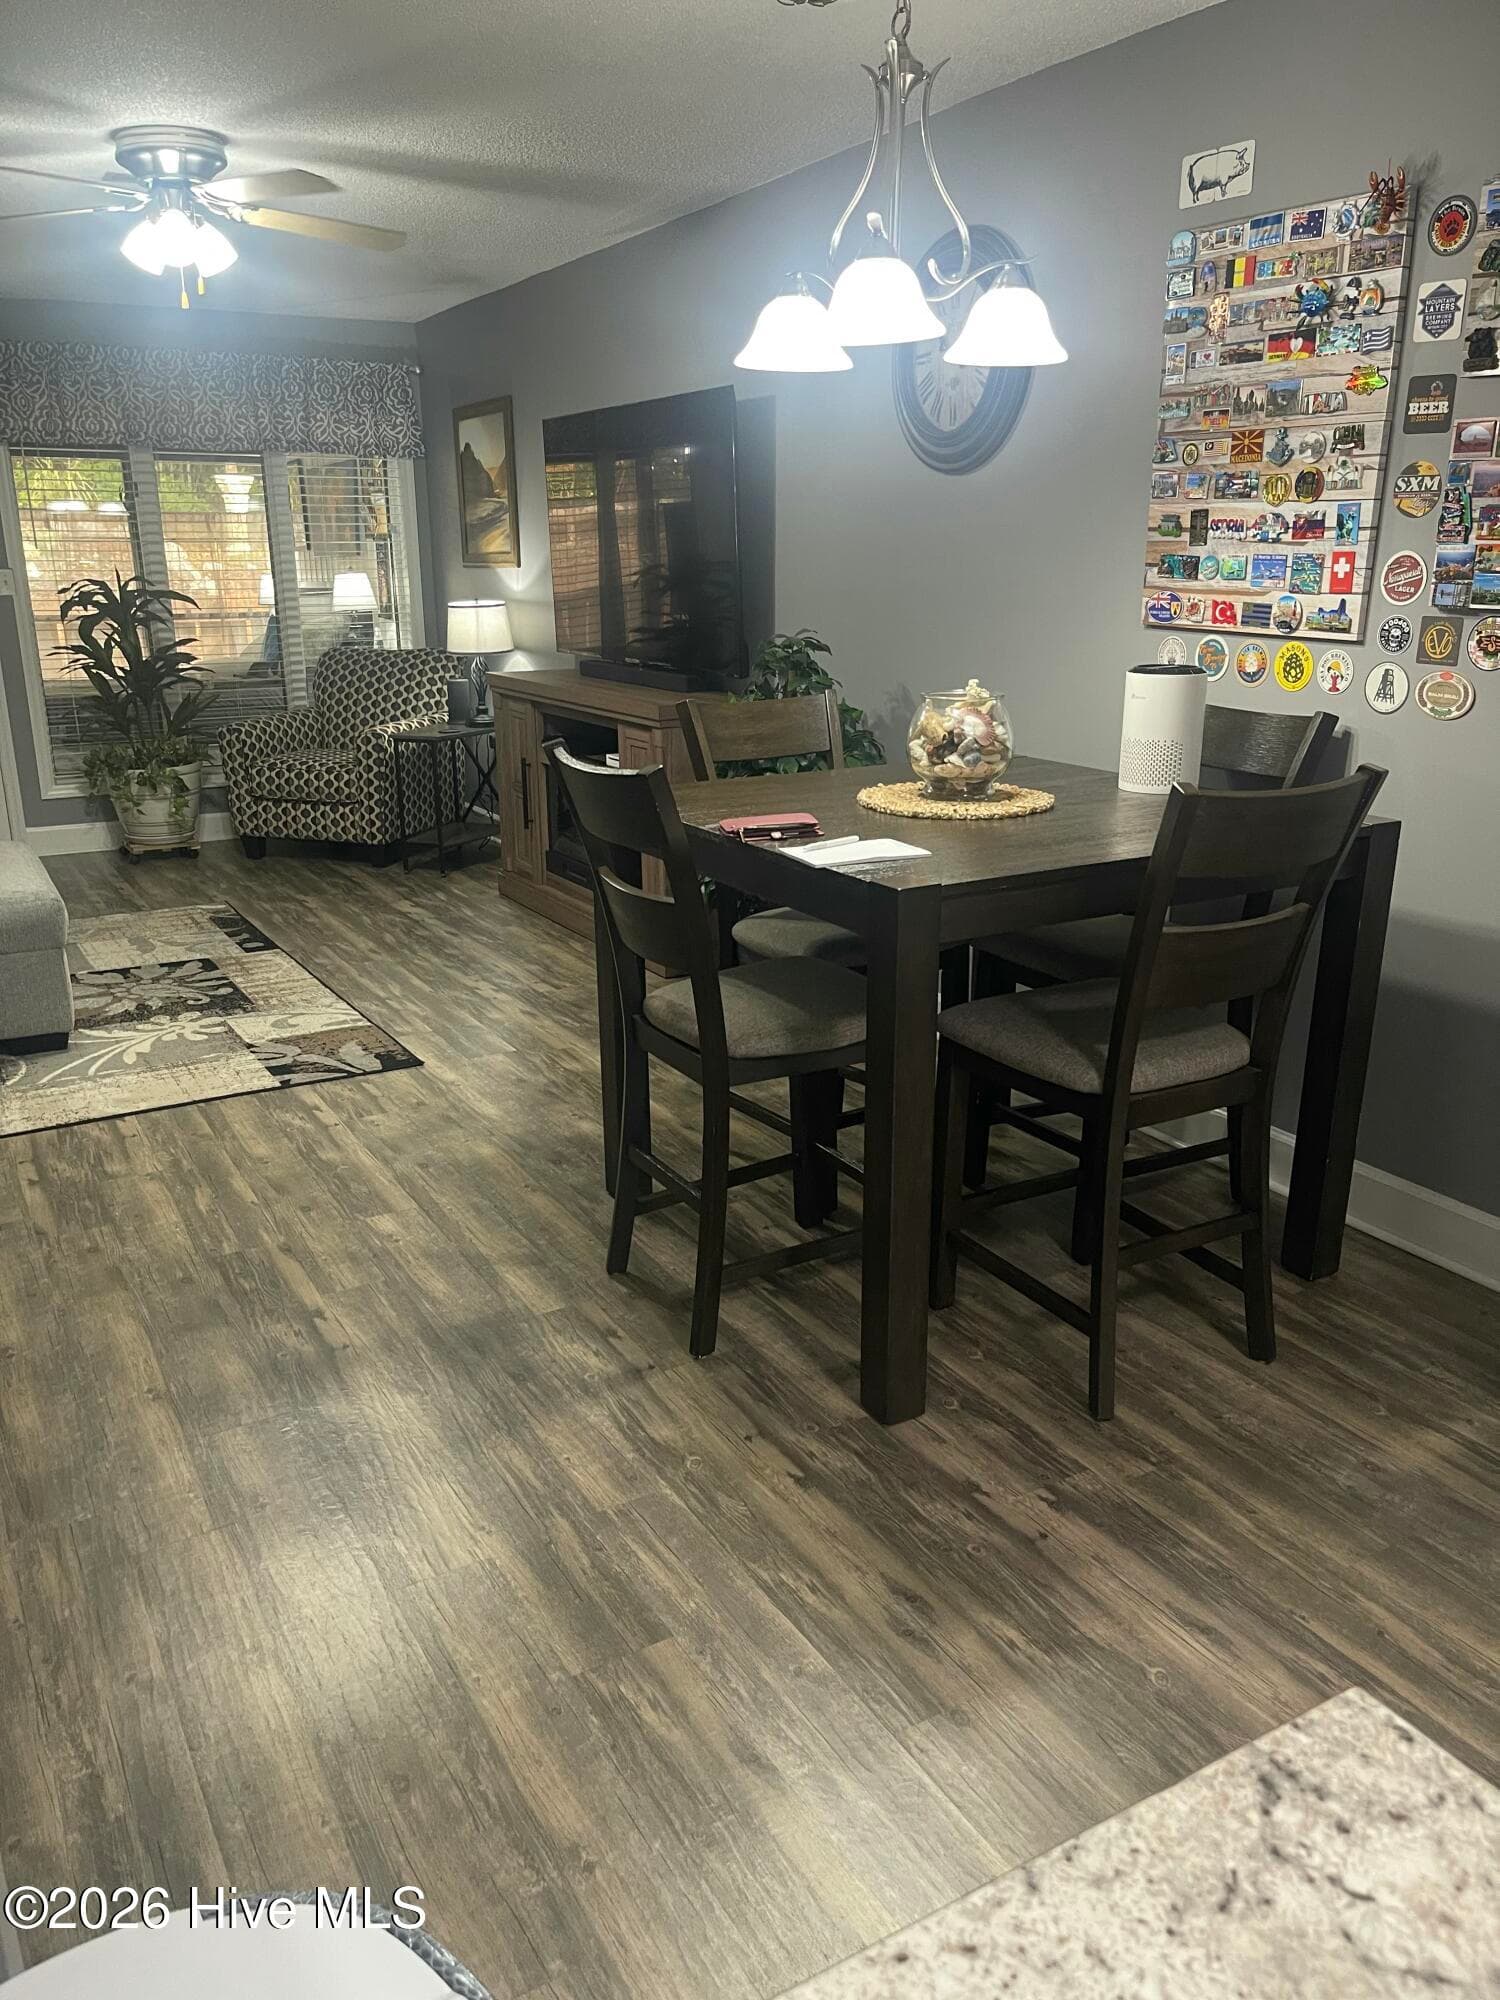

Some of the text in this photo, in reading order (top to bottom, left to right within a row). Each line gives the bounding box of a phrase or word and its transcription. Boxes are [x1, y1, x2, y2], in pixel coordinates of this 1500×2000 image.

[1425, 297, 1456, 305] MOUNTAIN
[1425, 302, 1456, 313] LAYERS
[1407, 401, 1450, 416] BEER
[1231, 453, 1262, 464] MACEDONIA
[1394, 475, 1441, 493] SXM
[1394, 585, 1416, 593] LAGER
